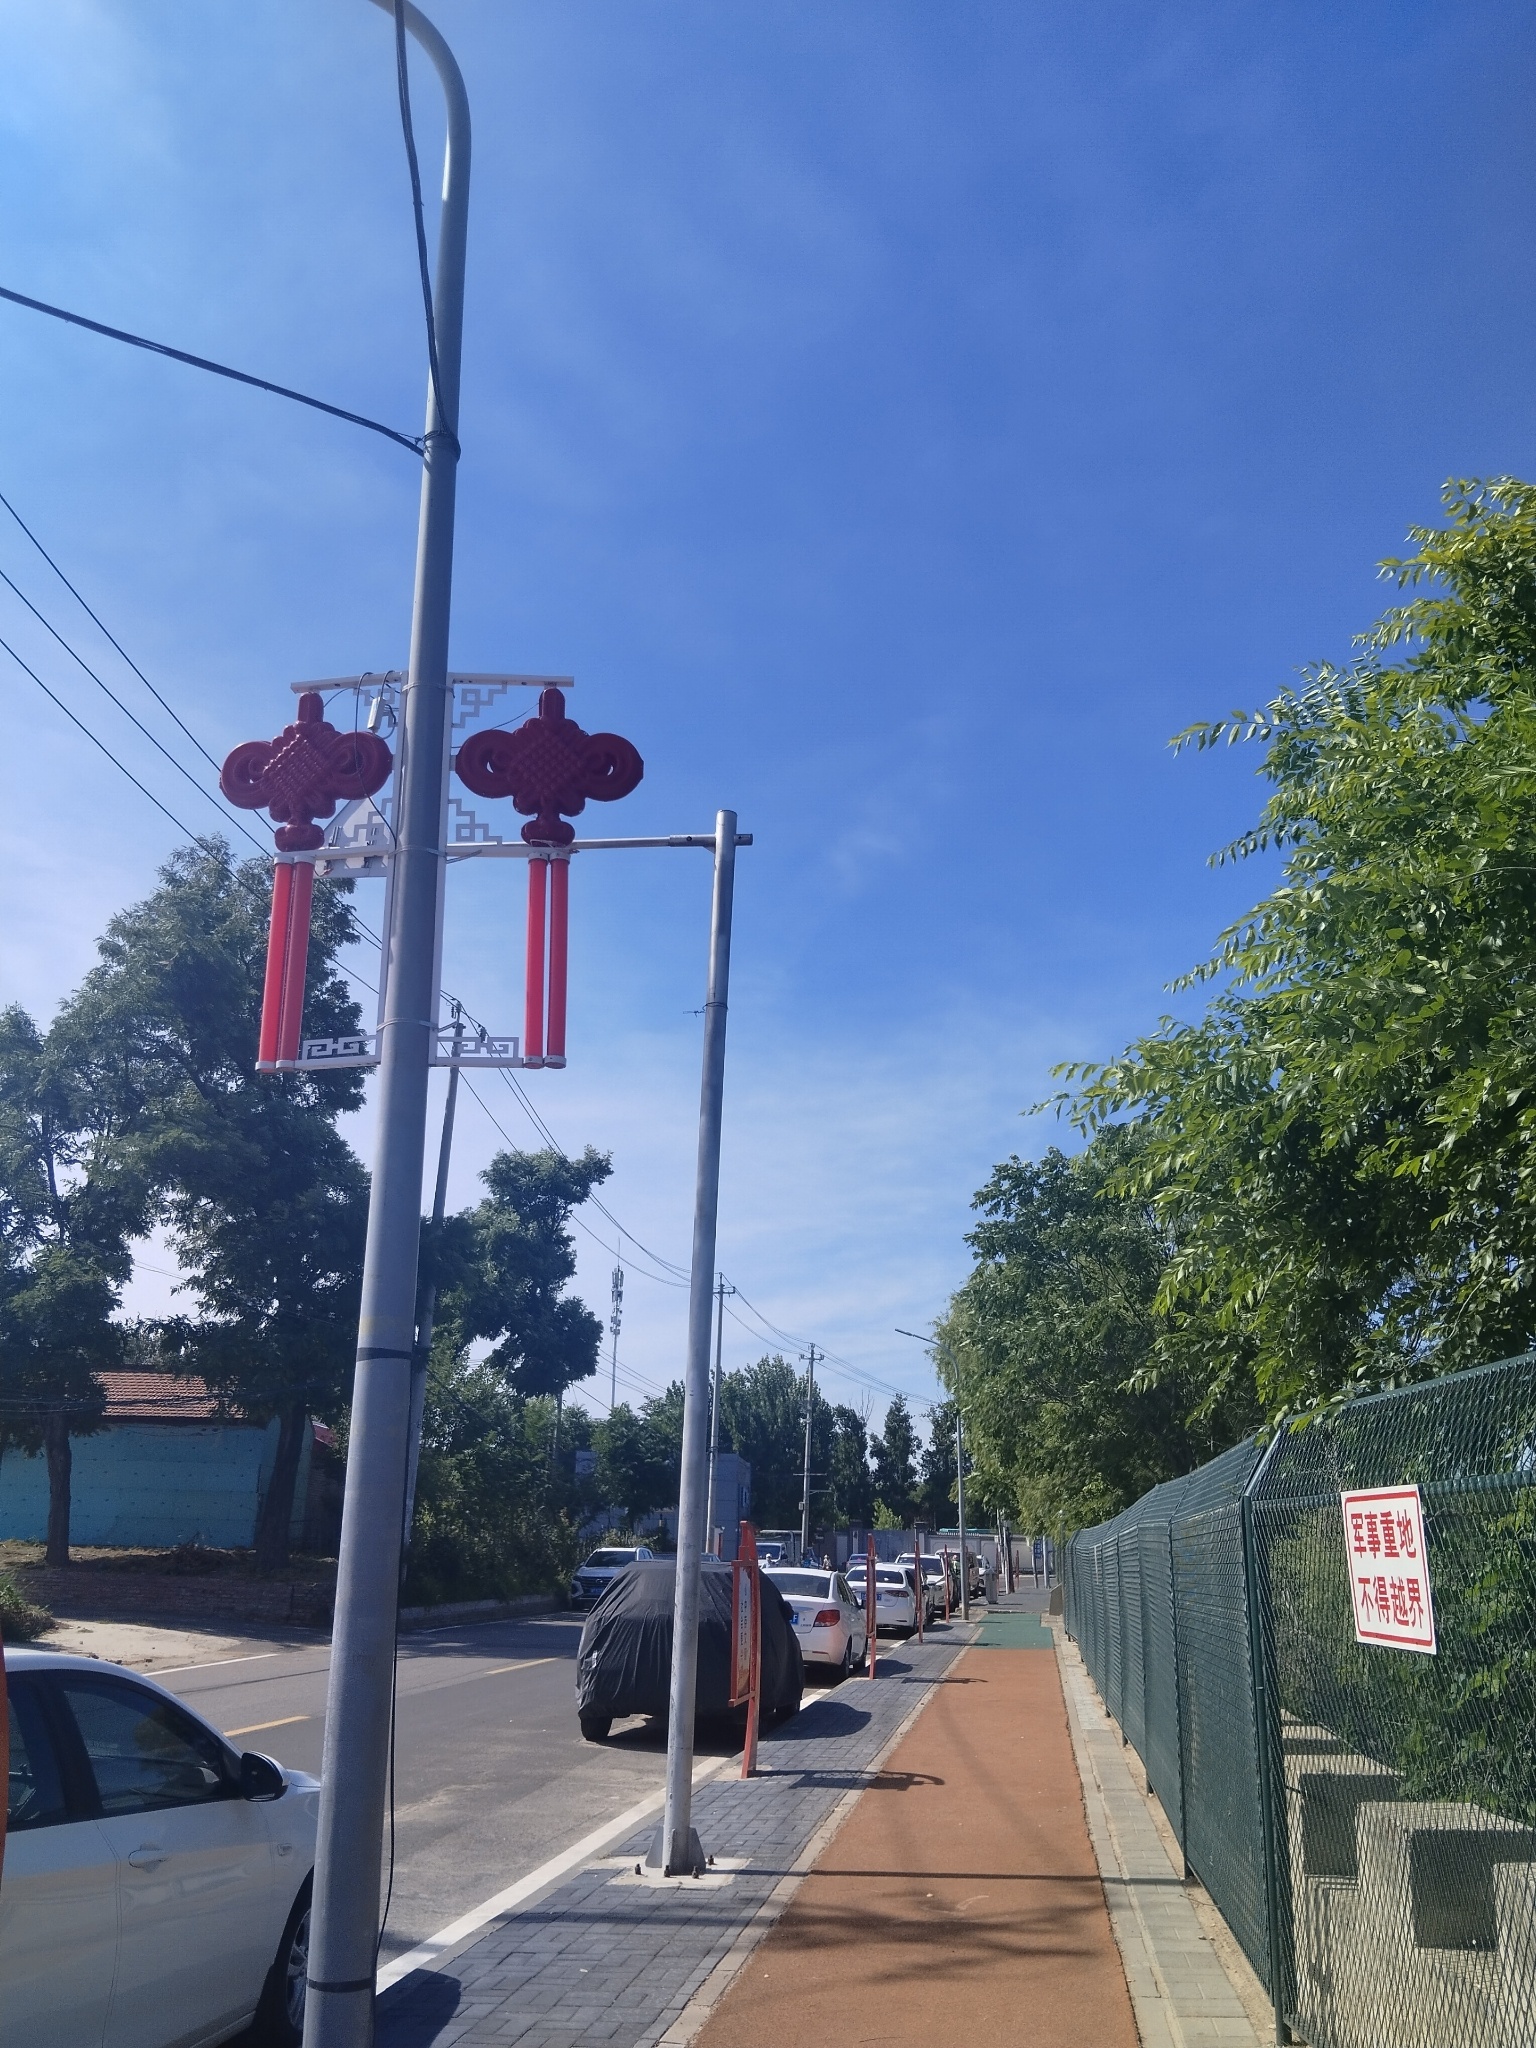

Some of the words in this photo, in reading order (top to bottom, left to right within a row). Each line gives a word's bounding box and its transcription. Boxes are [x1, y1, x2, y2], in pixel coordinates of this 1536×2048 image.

[1350, 1509, 1417, 1559] 军事重地
[1358, 1575, 1424, 1629] 不得越界
